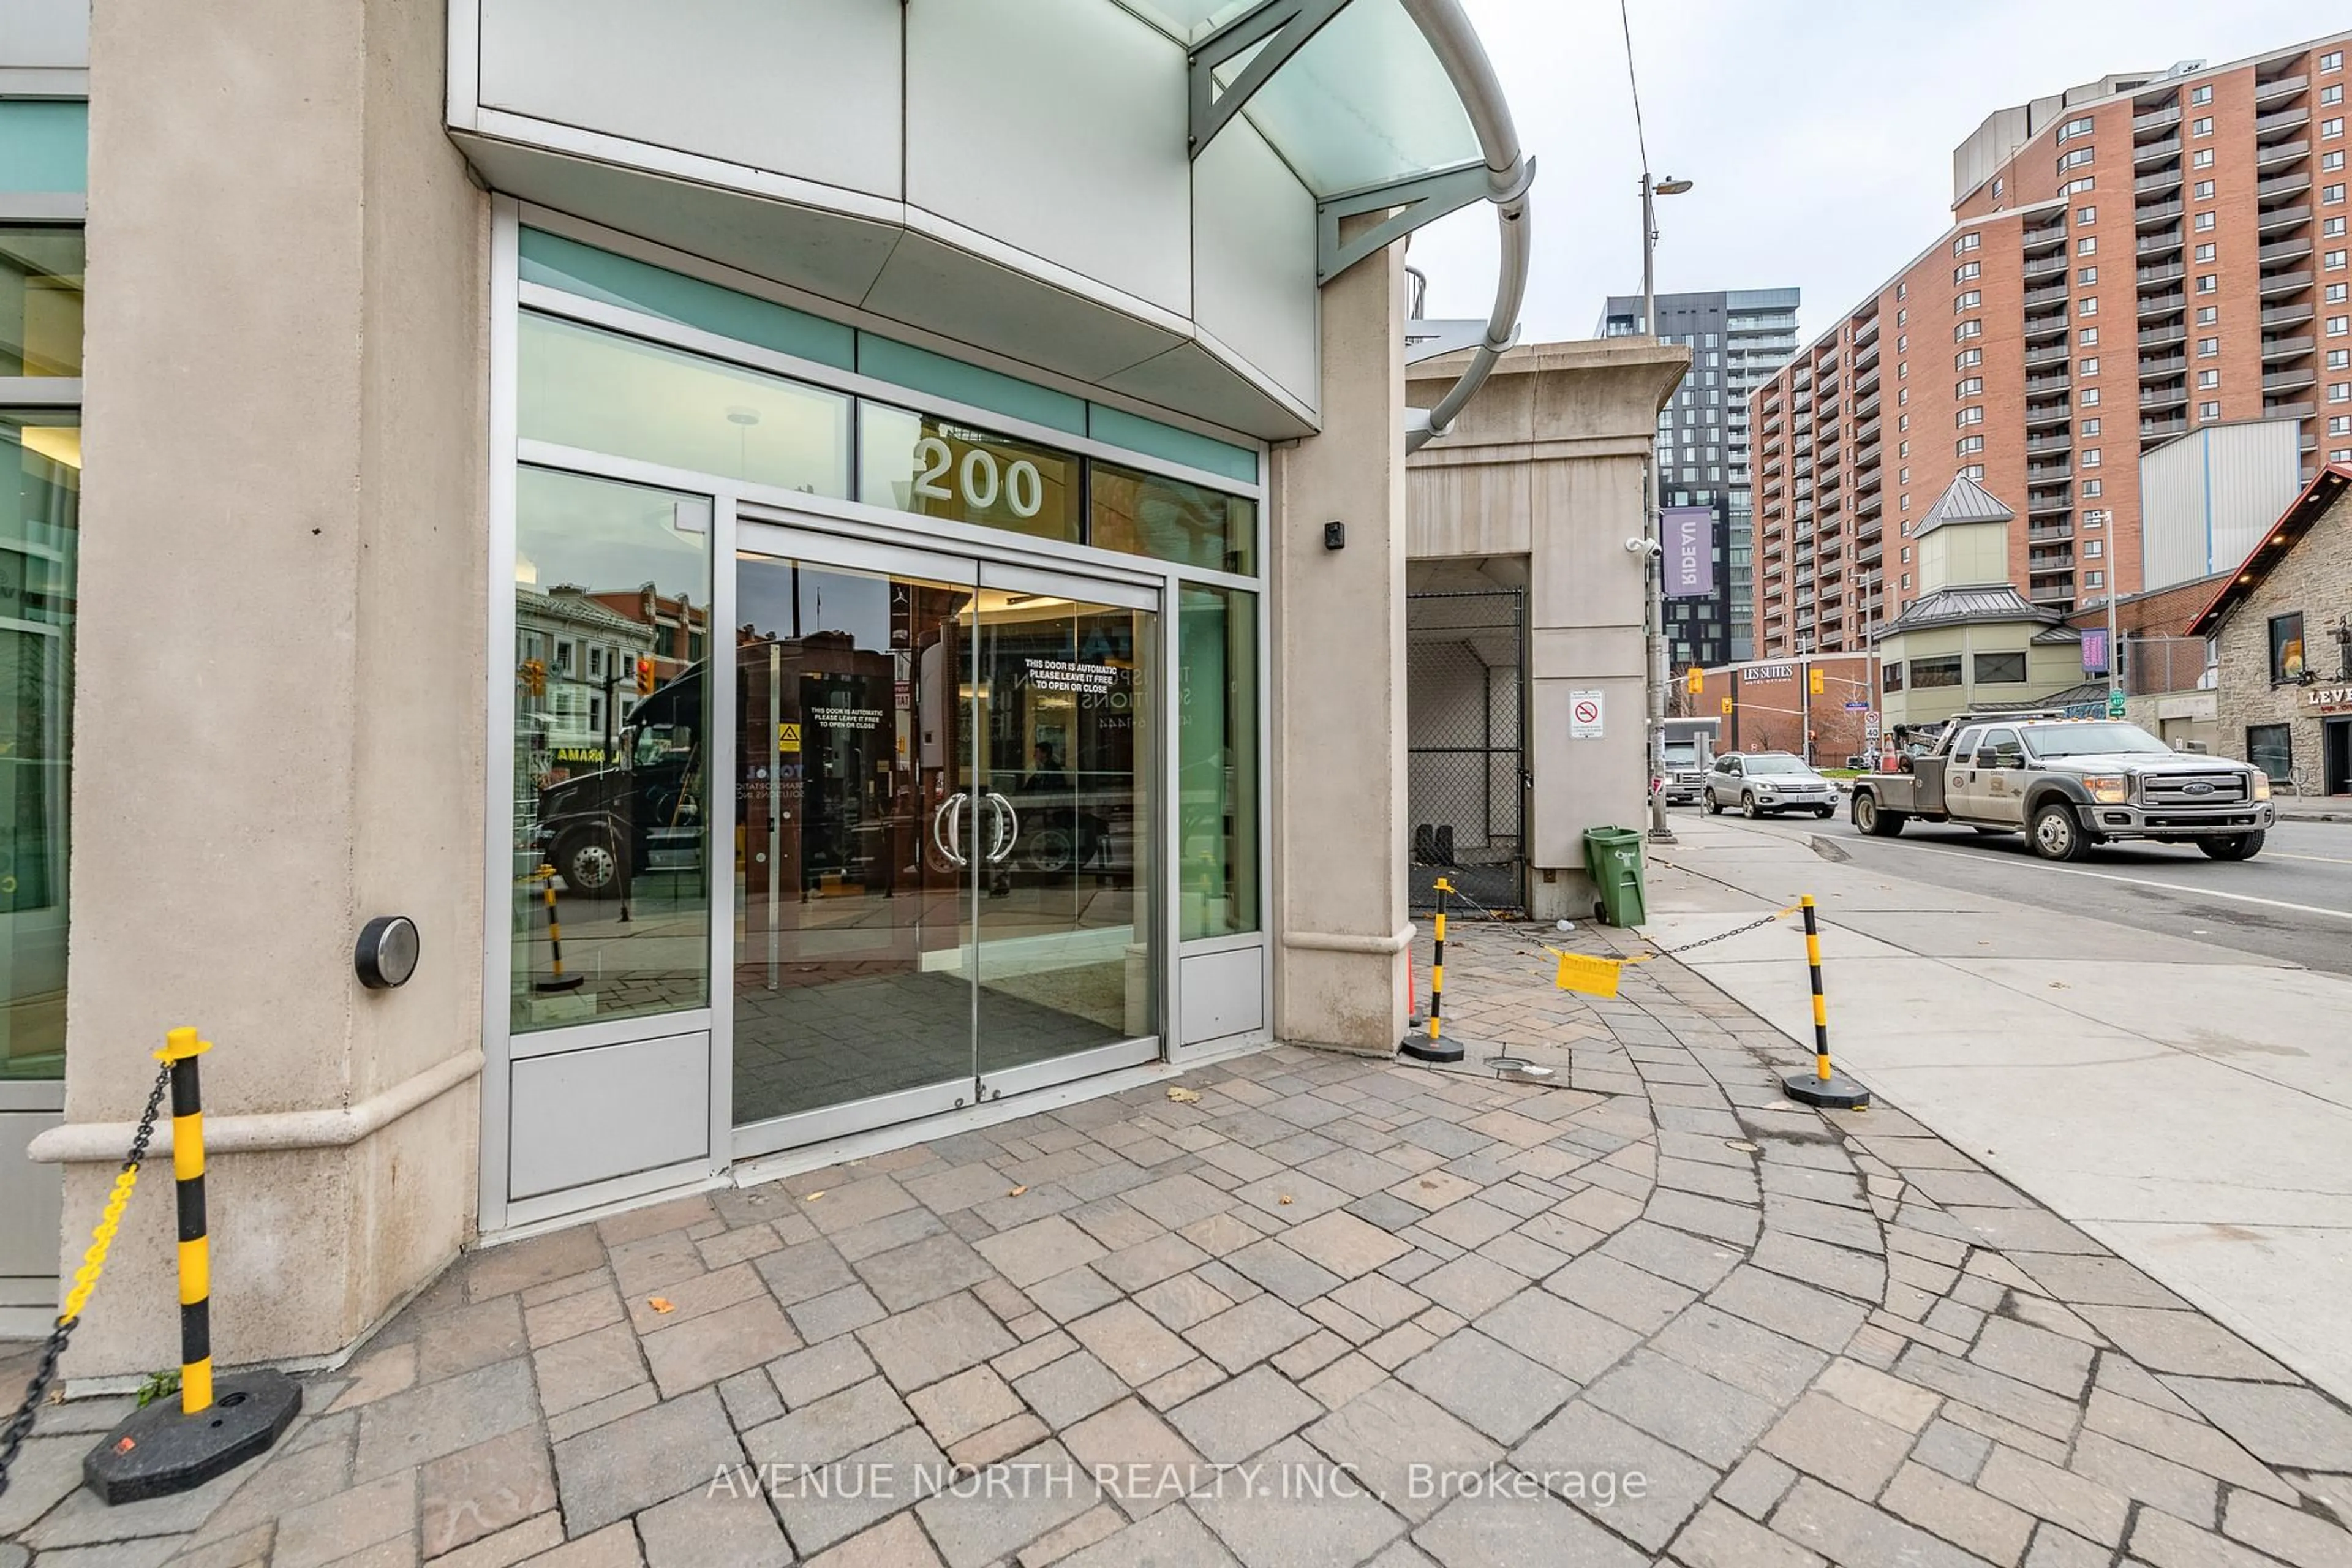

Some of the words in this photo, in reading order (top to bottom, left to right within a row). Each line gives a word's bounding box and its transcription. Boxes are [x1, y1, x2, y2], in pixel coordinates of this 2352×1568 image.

[913, 437, 1042, 518] 200
[1025, 658, 1043, 668] THIS
[1044, 660, 1067, 671] DOOR
[1068, 662, 1076, 671] IS
[1077, 663, 1117, 674] AUTOMATIC
[1744, 668, 1759, 680] LES
[1760, 665, 1793, 678] SUITES
[1030, 669, 1060, 680] PLEASE
[1061, 671, 1085, 682] LEAVE
[1094, 675, 1113, 684] FREE
[1036, 680, 1047, 690] TO
[1049, 681, 1069, 691] OPEN
[1071, 683, 1082, 692] OR
[1083, 684, 1107, 693] CLOSE
